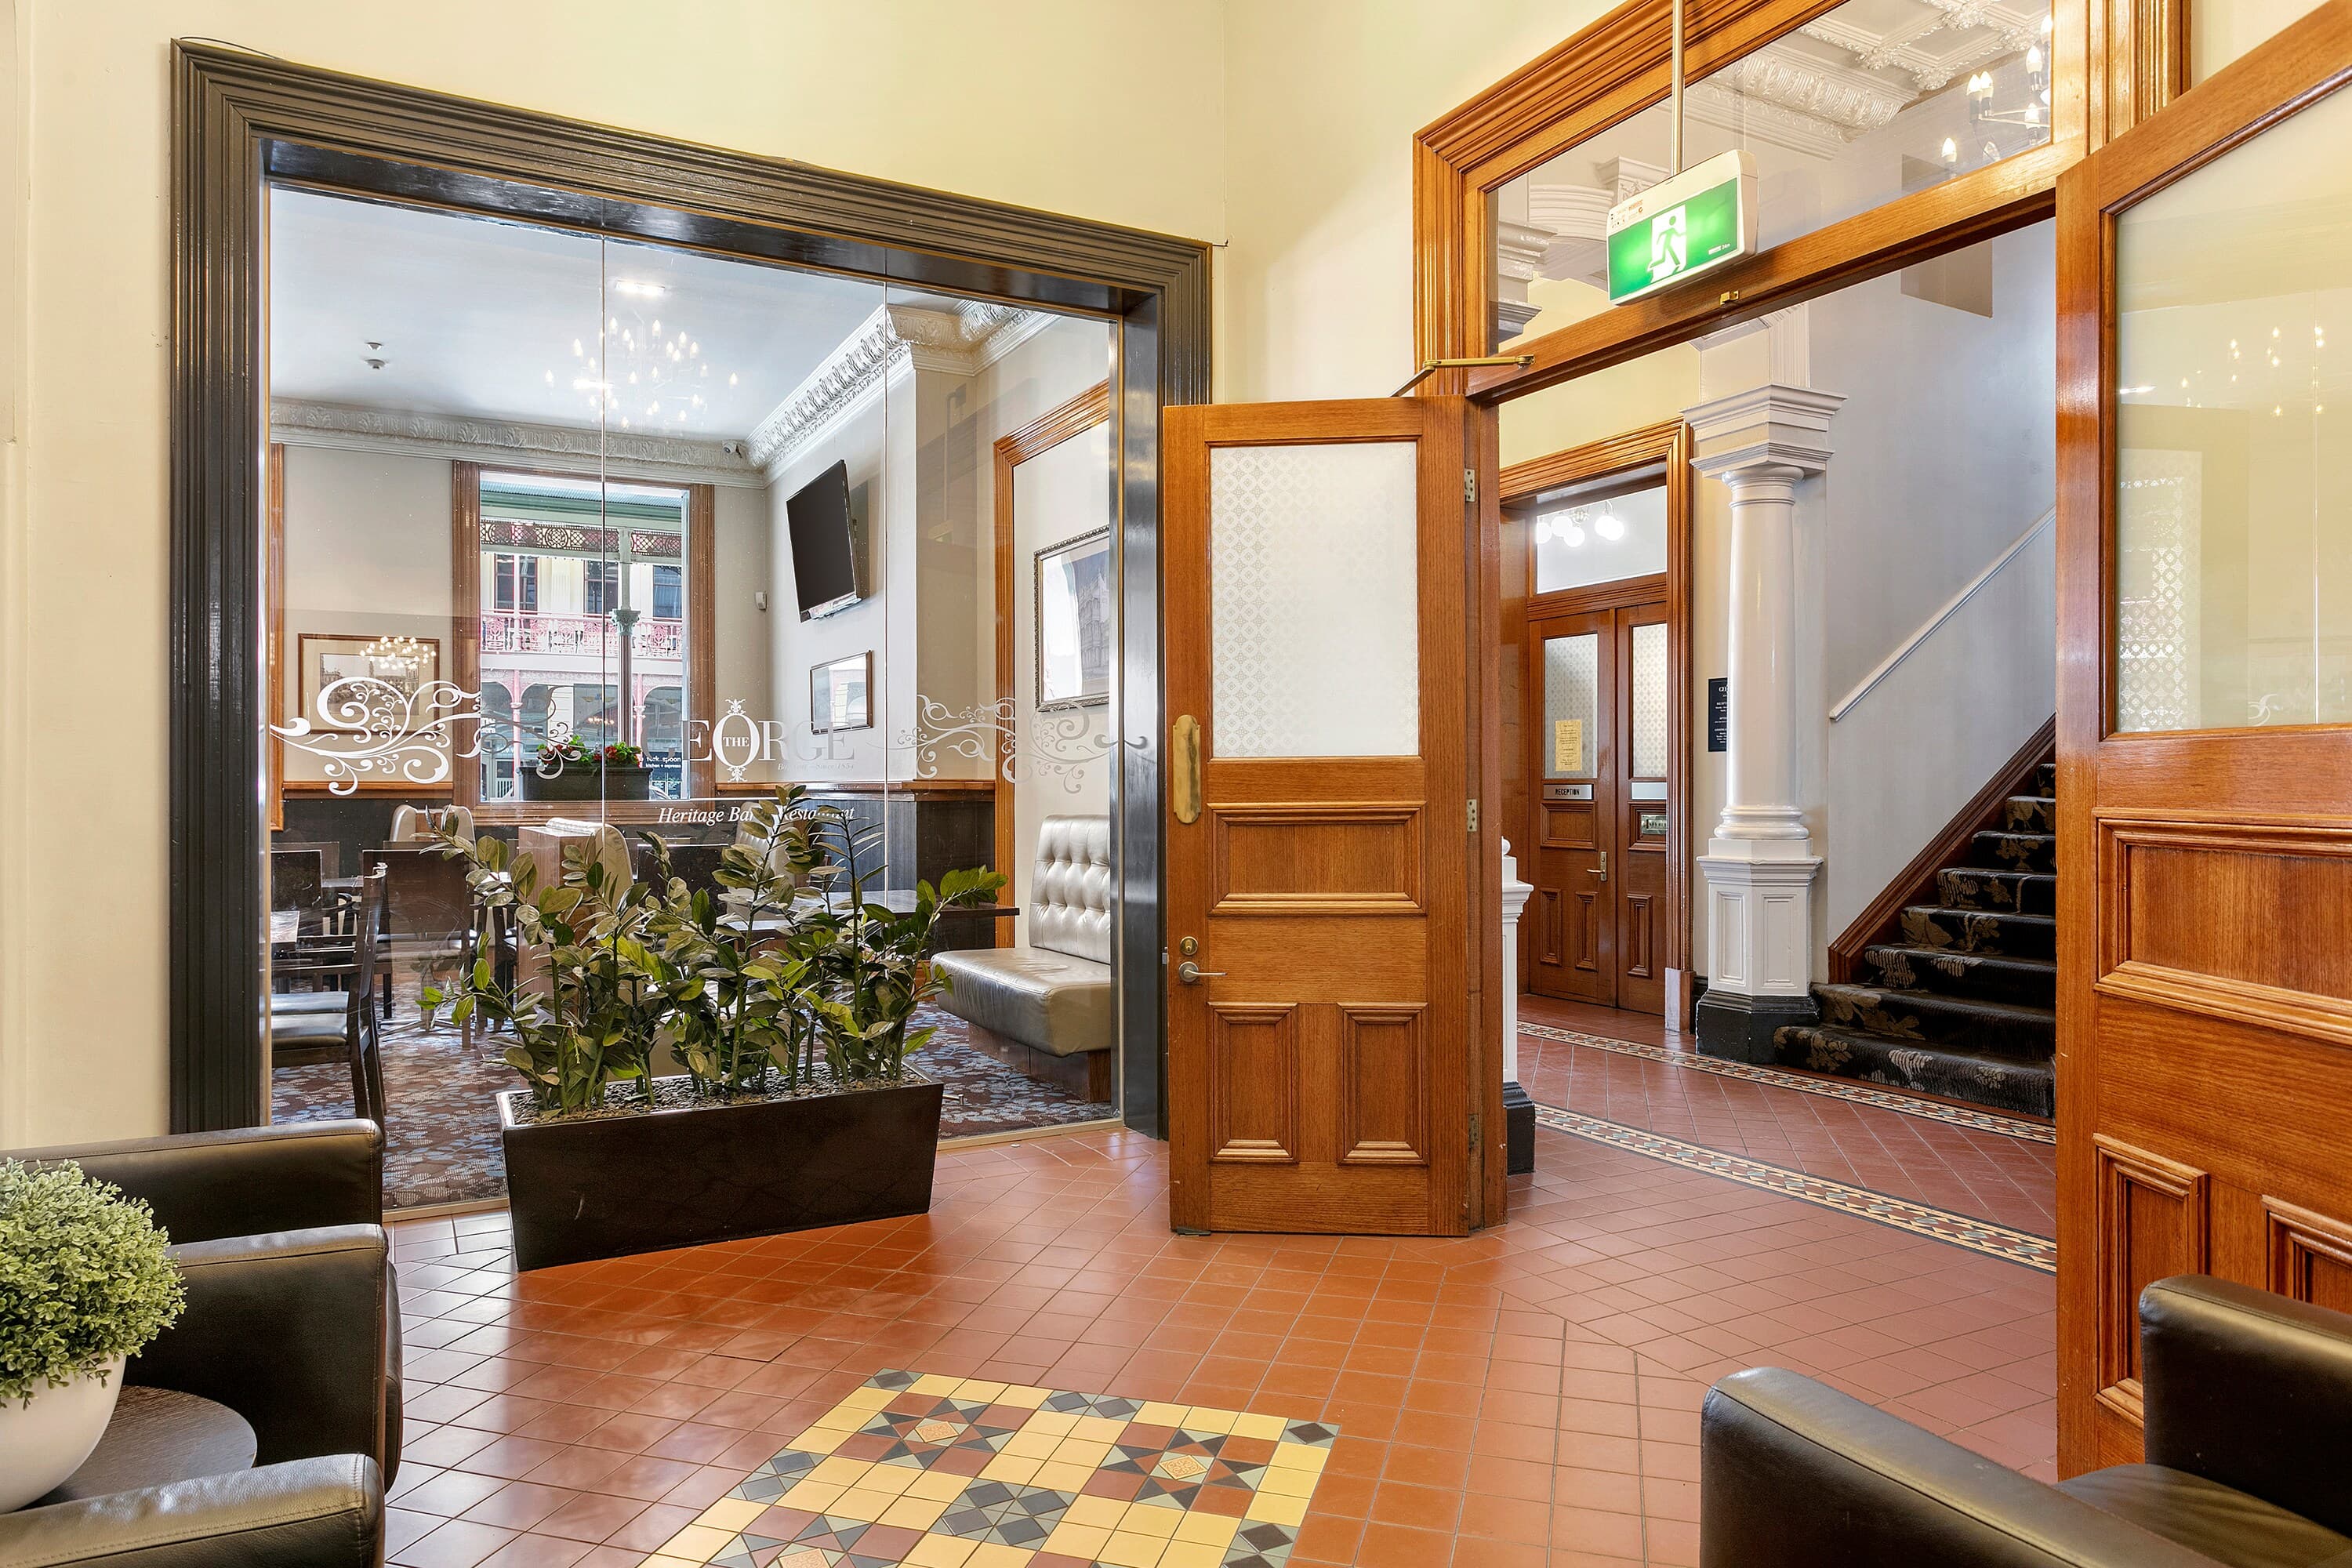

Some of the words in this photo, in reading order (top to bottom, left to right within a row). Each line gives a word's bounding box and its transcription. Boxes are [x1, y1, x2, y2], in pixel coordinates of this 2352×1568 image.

[641, 714, 855, 768] GEORGE
[723, 737, 750, 746] THE
[657, 808, 724, 826] Heritage
